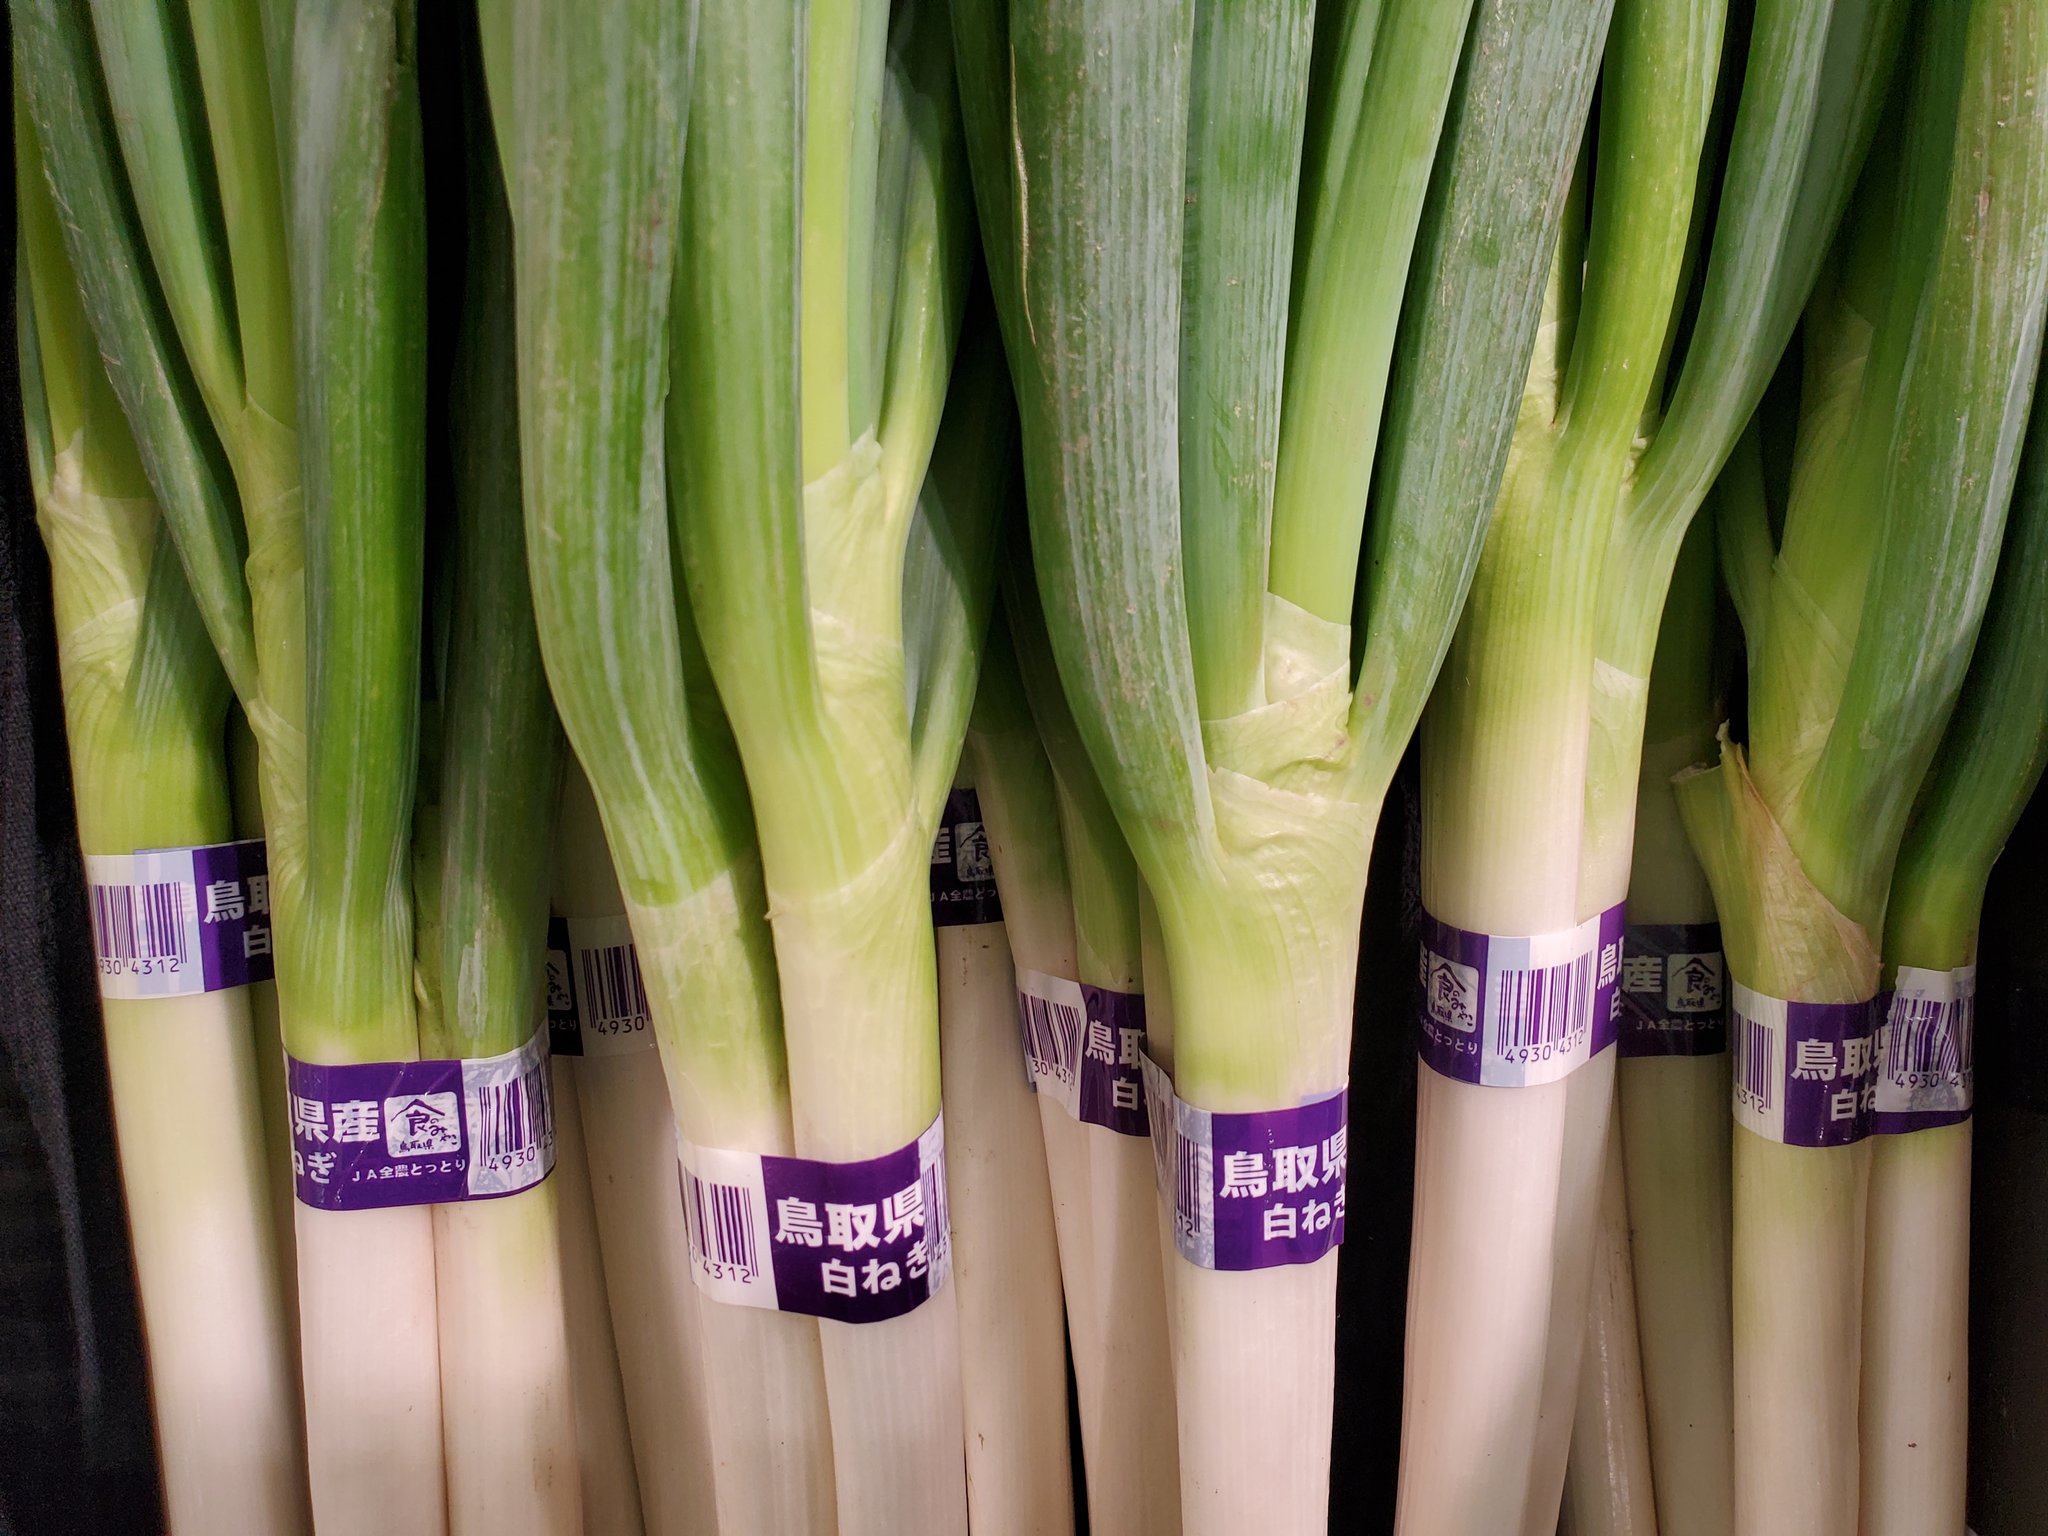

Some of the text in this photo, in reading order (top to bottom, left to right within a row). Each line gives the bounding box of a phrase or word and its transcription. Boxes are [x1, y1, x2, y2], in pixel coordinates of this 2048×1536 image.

[131, 957, 181, 976] 4312
[1596, 936, 1625, 991] 鳥
[598, 1014, 645, 1036] 4930
[1504, 1029, 1585, 1065] 4930 4312
[1111, 1076, 1139, 1112] 白
[1894, 1072, 1940, 1089] 4930
[291, 1093, 381, 1144] 県産
[487, 1146, 537, 1173] 4930
[773, 1178, 925, 1253] 鳥取県
[702, 1258, 753, 1285] 4312
